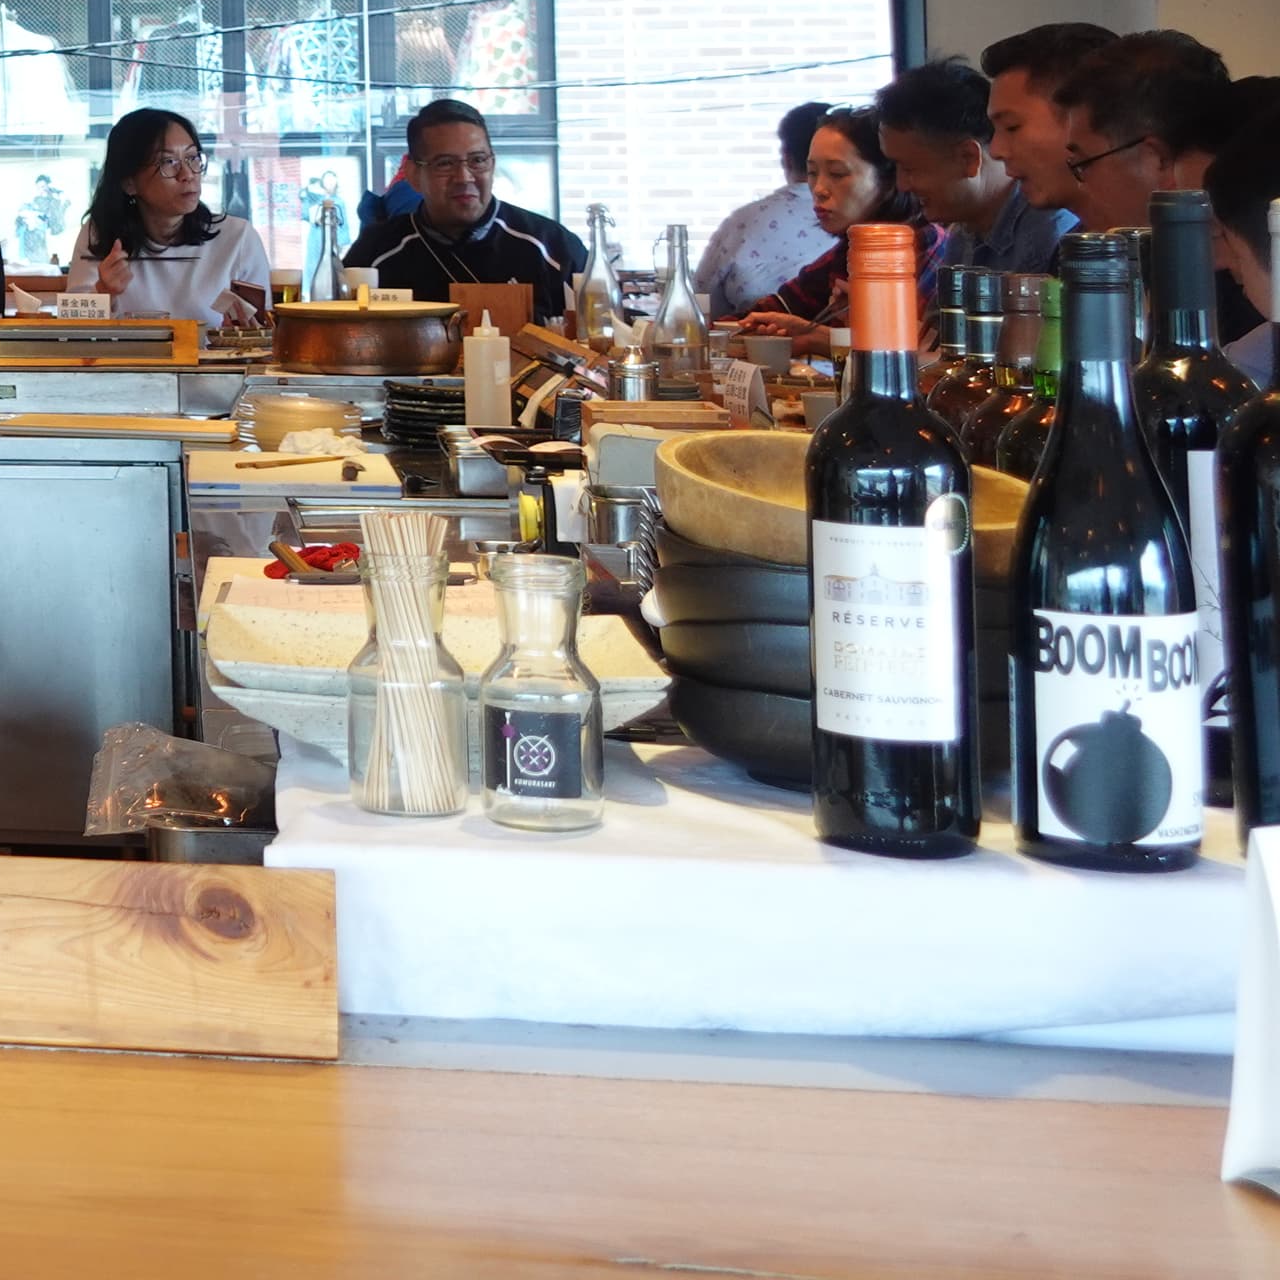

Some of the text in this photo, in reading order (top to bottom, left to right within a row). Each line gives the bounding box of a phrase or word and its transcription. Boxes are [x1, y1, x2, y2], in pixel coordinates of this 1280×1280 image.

[831, 609, 926, 629] RÉSERVE
[1034, 615, 1143, 679] BOOM
[823, 687, 873, 703] CABERNET
